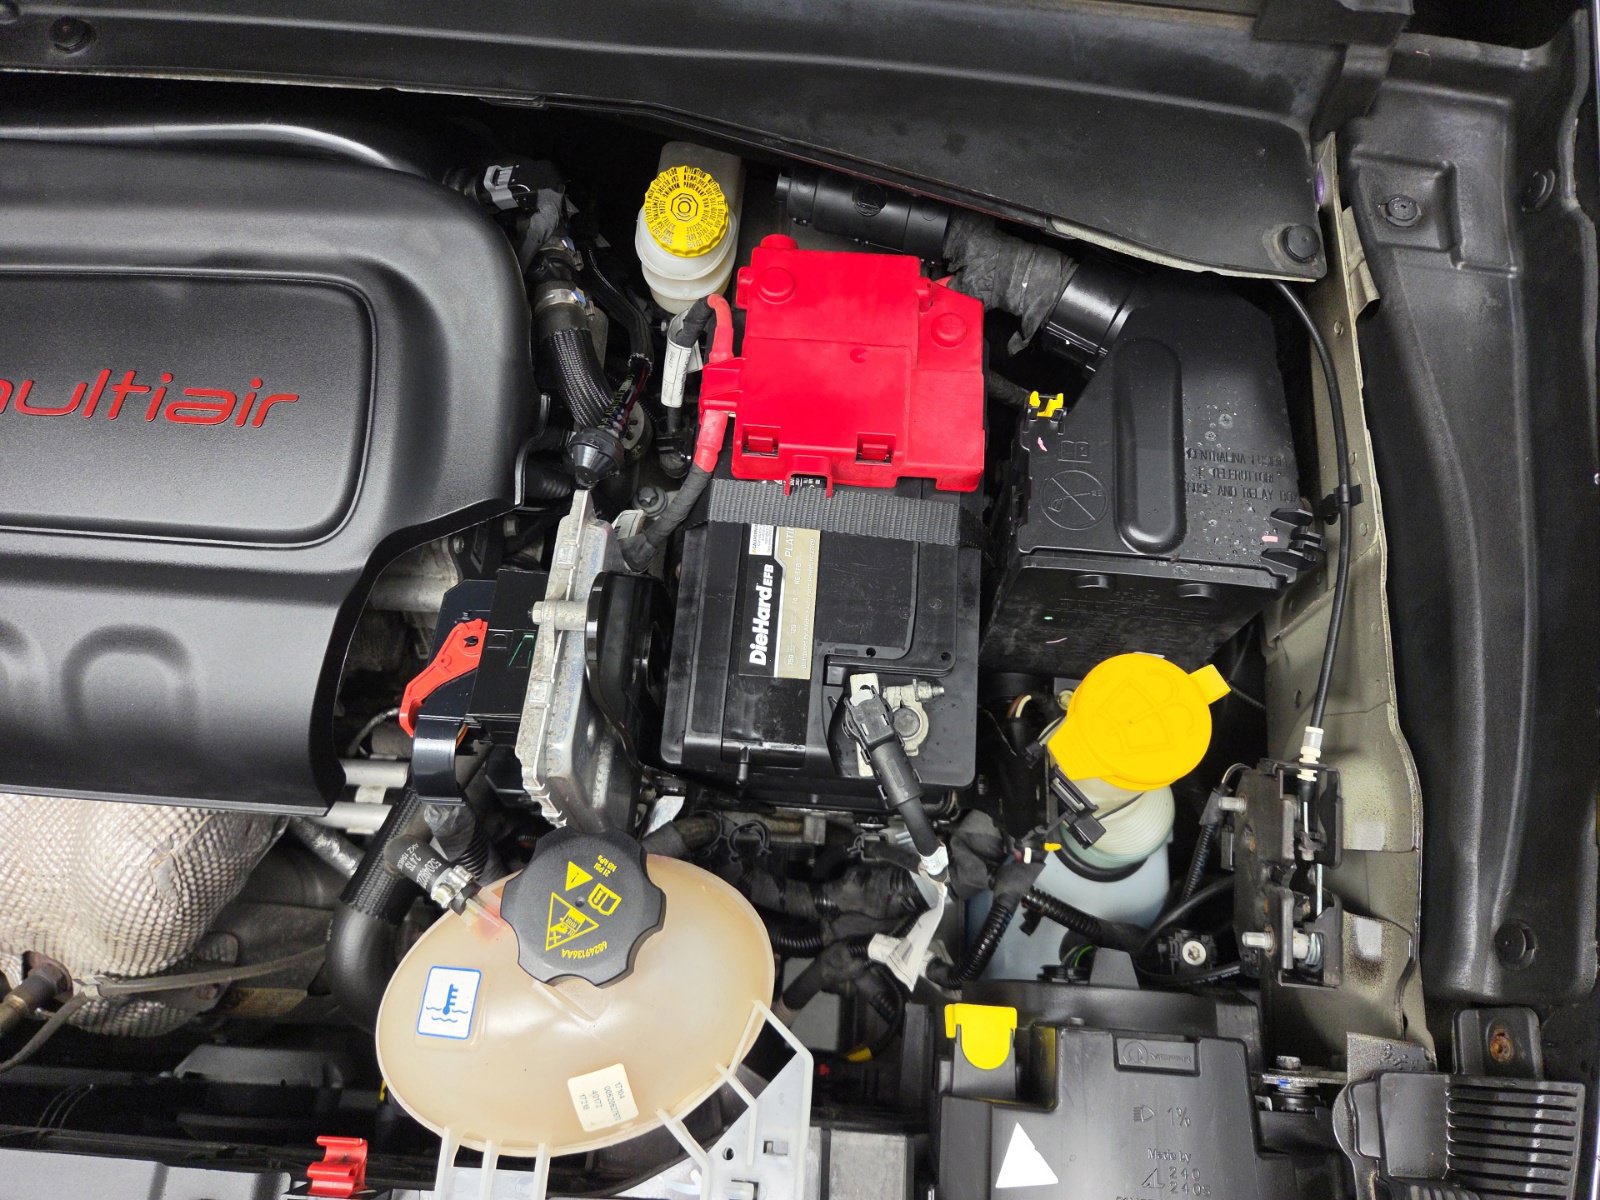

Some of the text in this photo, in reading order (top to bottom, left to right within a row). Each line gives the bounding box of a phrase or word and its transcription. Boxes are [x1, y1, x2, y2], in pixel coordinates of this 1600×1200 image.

[0, 368, 300, 428] ultiair
[1218, 485, 1237, 497] AND
[749, 584, 773, 666] DieHard
[763, 564, 774, 586] EFB
[592, 861, 605, 873] PSI
[561, 940, 608, 959] 68249136AA
[1147, 1147, 1192, 1164] Made by
